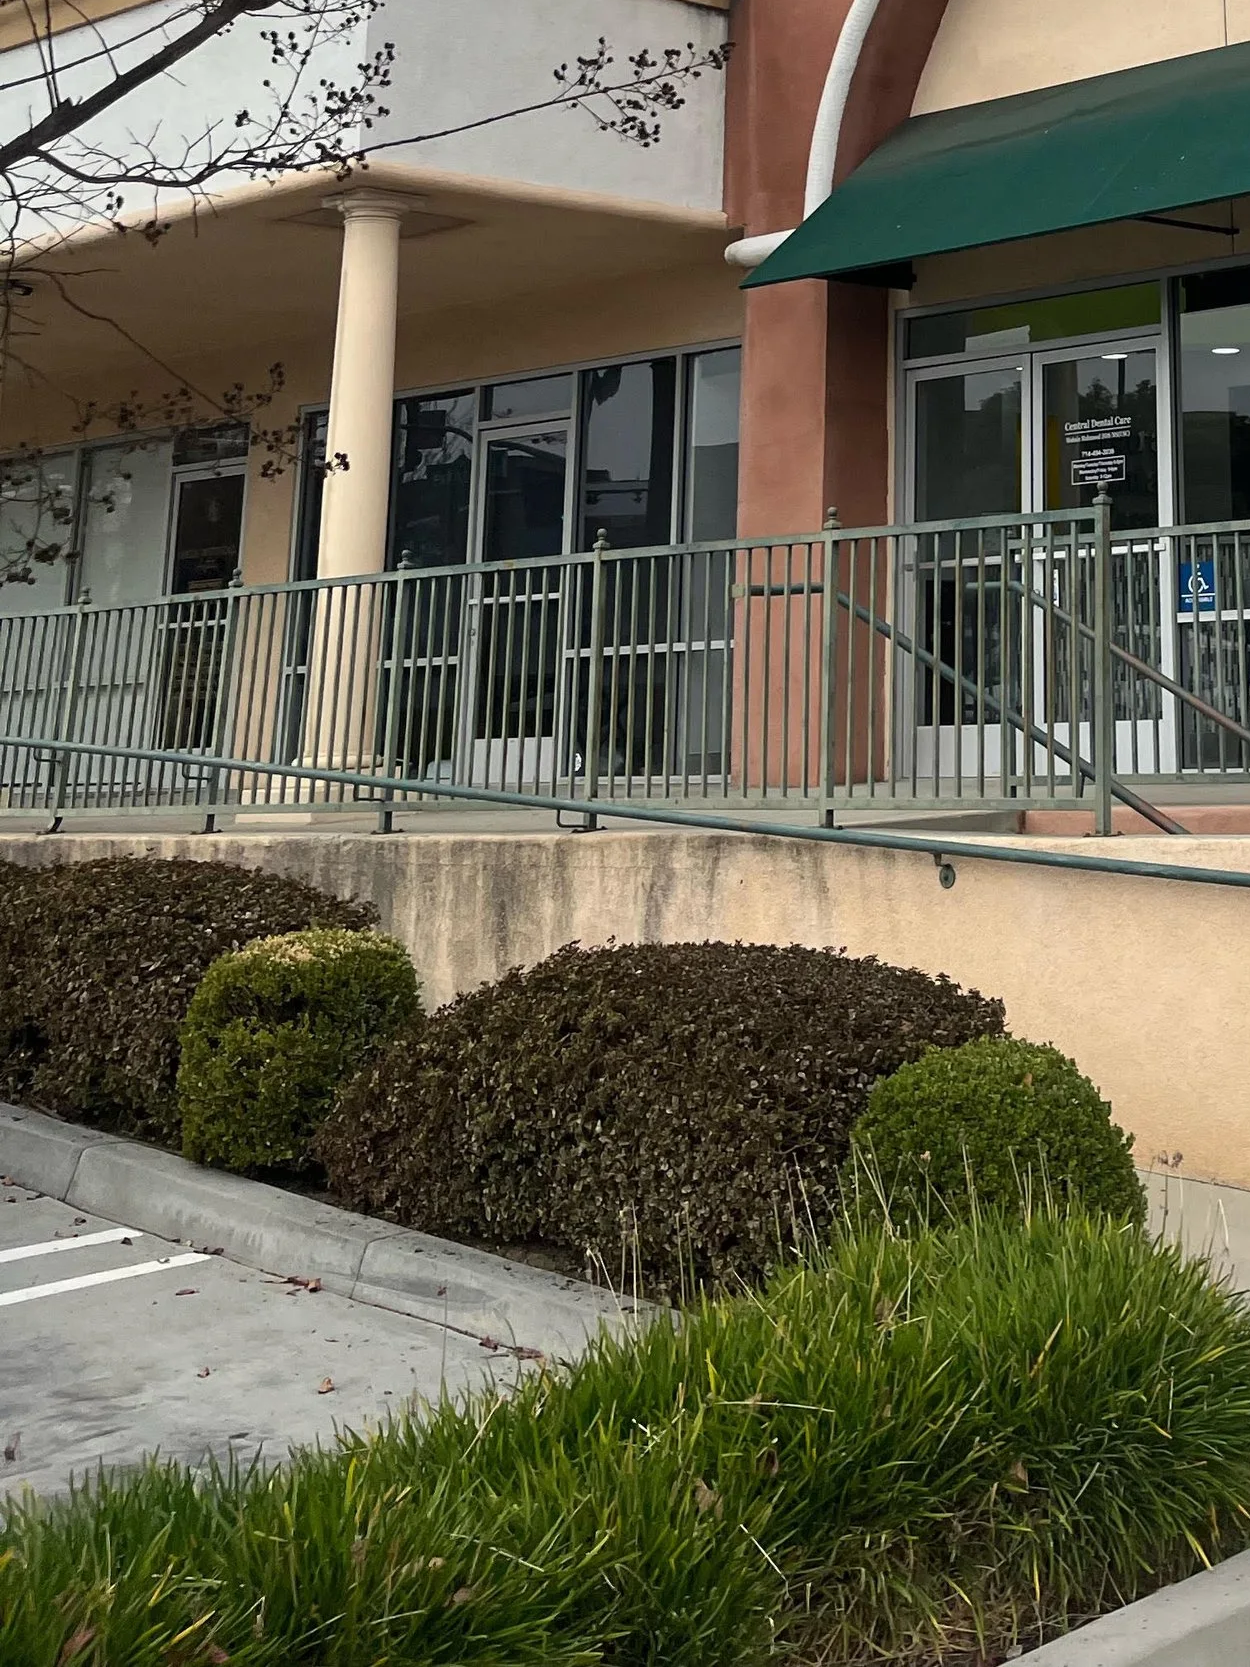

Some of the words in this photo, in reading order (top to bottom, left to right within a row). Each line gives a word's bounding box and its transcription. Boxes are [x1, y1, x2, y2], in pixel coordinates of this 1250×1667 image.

[1065, 419, 1090, 431] Central
[1091, 416, 1113, 428] Dental
[1115, 416, 1131, 425] Care
